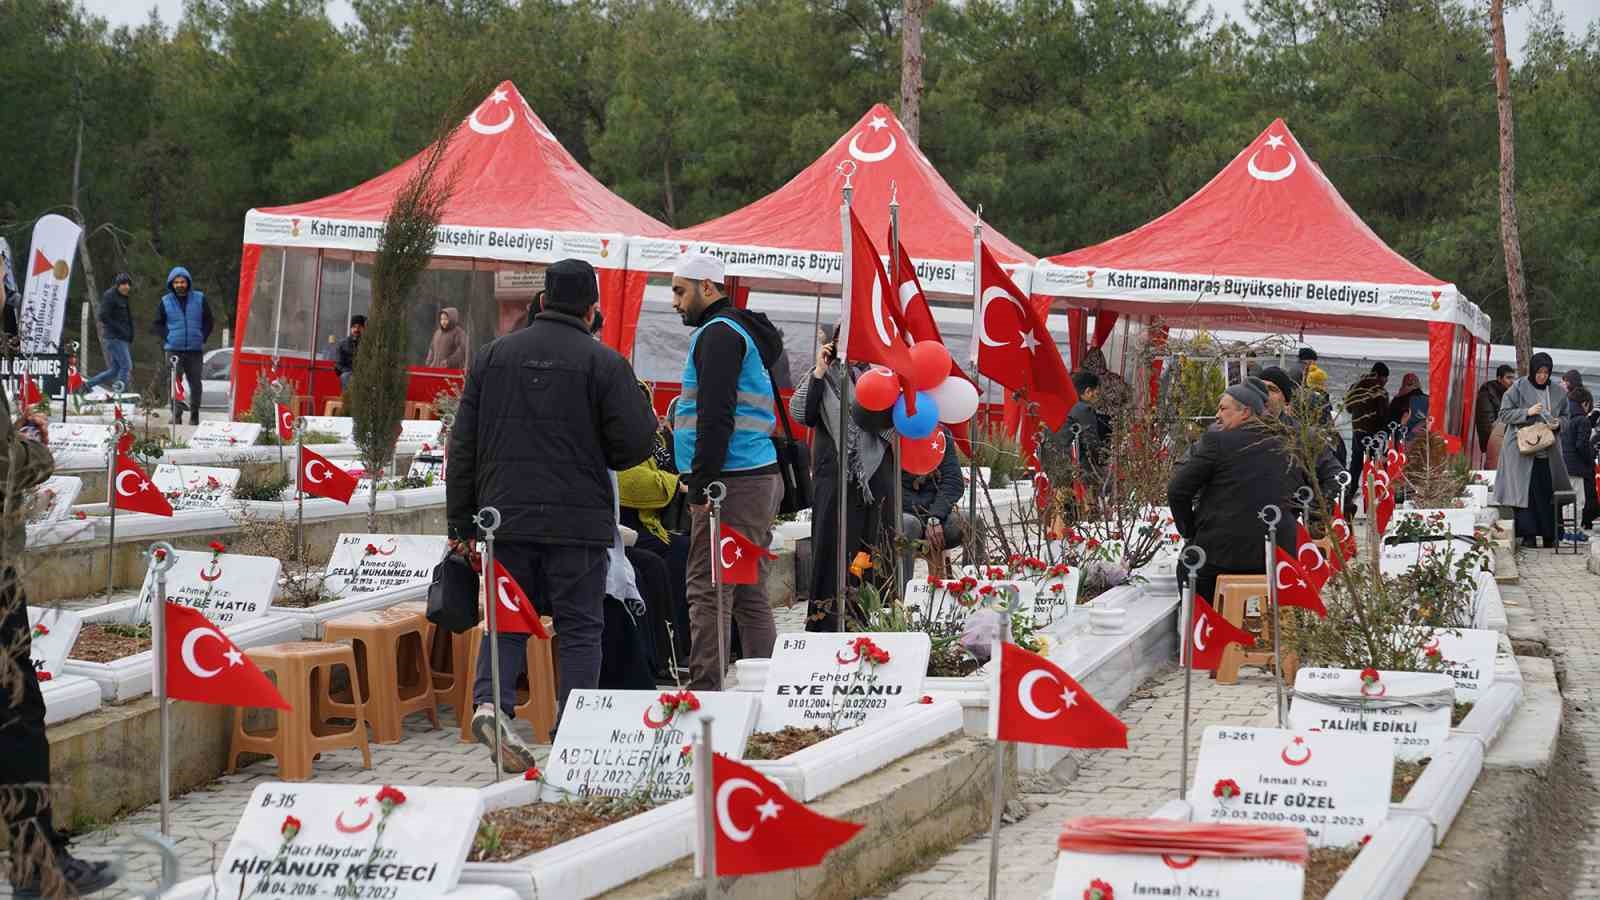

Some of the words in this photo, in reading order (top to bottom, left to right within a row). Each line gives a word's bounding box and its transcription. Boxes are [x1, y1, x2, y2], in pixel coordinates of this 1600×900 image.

[436, 228, 486, 247] ükşehir
[488, 231, 553, 253] Belediyesi
[1107, 271, 1220, 295] Kahramanmaraş
[1224, 279, 1303, 299] Büyükşehir
[1306, 283, 1379, 306] Belediyesi
[361, 569, 412, 578] MUHAMMED
[784, 639, 806, 650] B-313
[811, 672, 849, 682] Fehed
[777, 685, 825, 696] EYE
[832, 685, 903, 696] NANU
[576, 696, 613, 711] B-314
[1320, 719, 1368, 732] TALİHA
[1218, 731, 1255, 741] B-261
[559, 745, 671, 768] ABDULKERİM
[1302, 777, 1328, 787] Kızı
[261, 792, 297, 808] B-315
[1244, 790, 1279, 806] ELİF
[1284, 793, 1336, 810] GÜZEL
[316, 844, 366, 860] Haydar
[229, 856, 341, 879] HİRANUR
[345, 861, 439, 884] KEÇECİ
[1133, 882, 1183, 897] İsmail
[1188, 886, 1221, 898] Kızı
